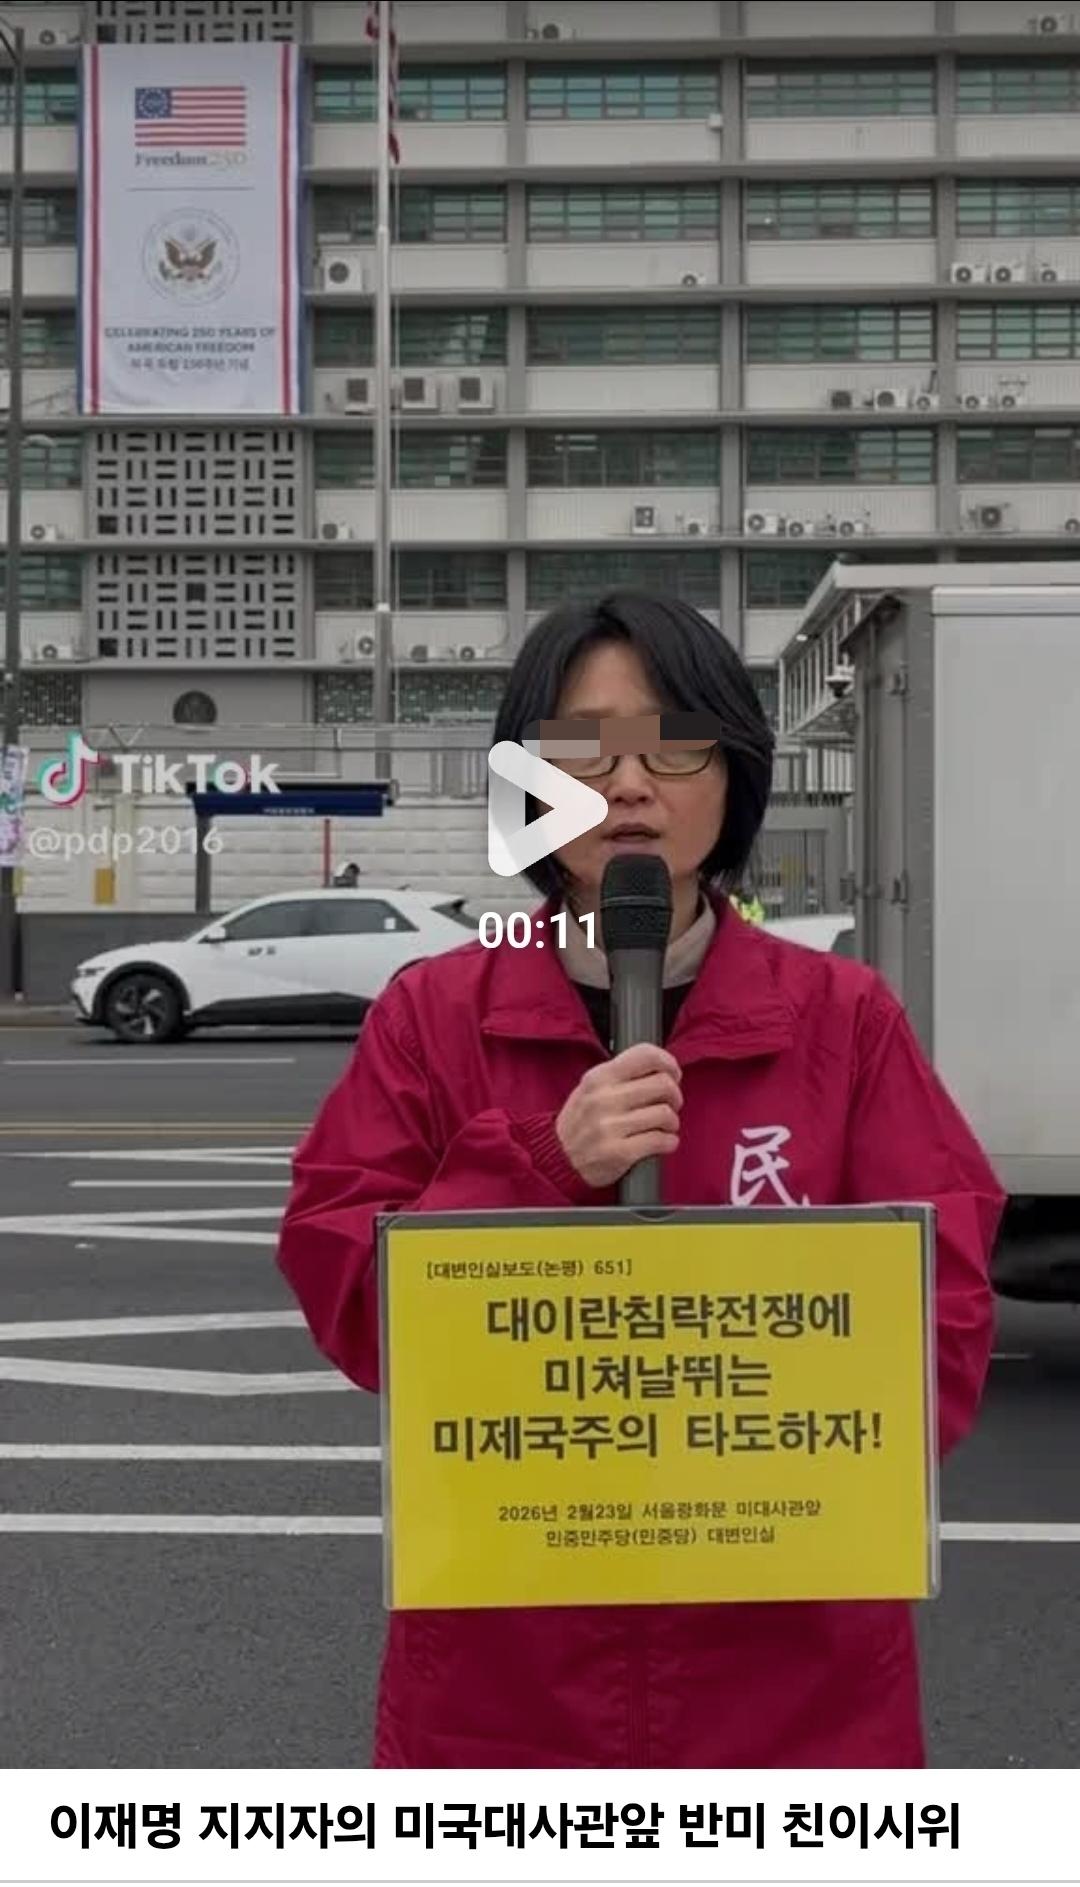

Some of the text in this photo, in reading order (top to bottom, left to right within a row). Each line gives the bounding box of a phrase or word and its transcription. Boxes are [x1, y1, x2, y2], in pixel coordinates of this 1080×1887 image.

[104, 326, 276, 339] CELEBRATING 250 YEARS OF
[127, 341, 255, 353] AMERICAN FREEDOM
[426, 1257, 633, 1280] [대변인실보도(논평) 651]
[487, 1292, 851, 1342] 대이란침략전쟁에
[544, 1353, 772, 1401] 미쳐날뛰는
[433, 1409, 882, 1462] 미제국주의 타도하자!
[498, 1499, 821, 1522] 2026년 2월23일 서울광화문 미대사관앞
[546, 1526, 775, 1547] 민중민주당(민중당) 대변인실
